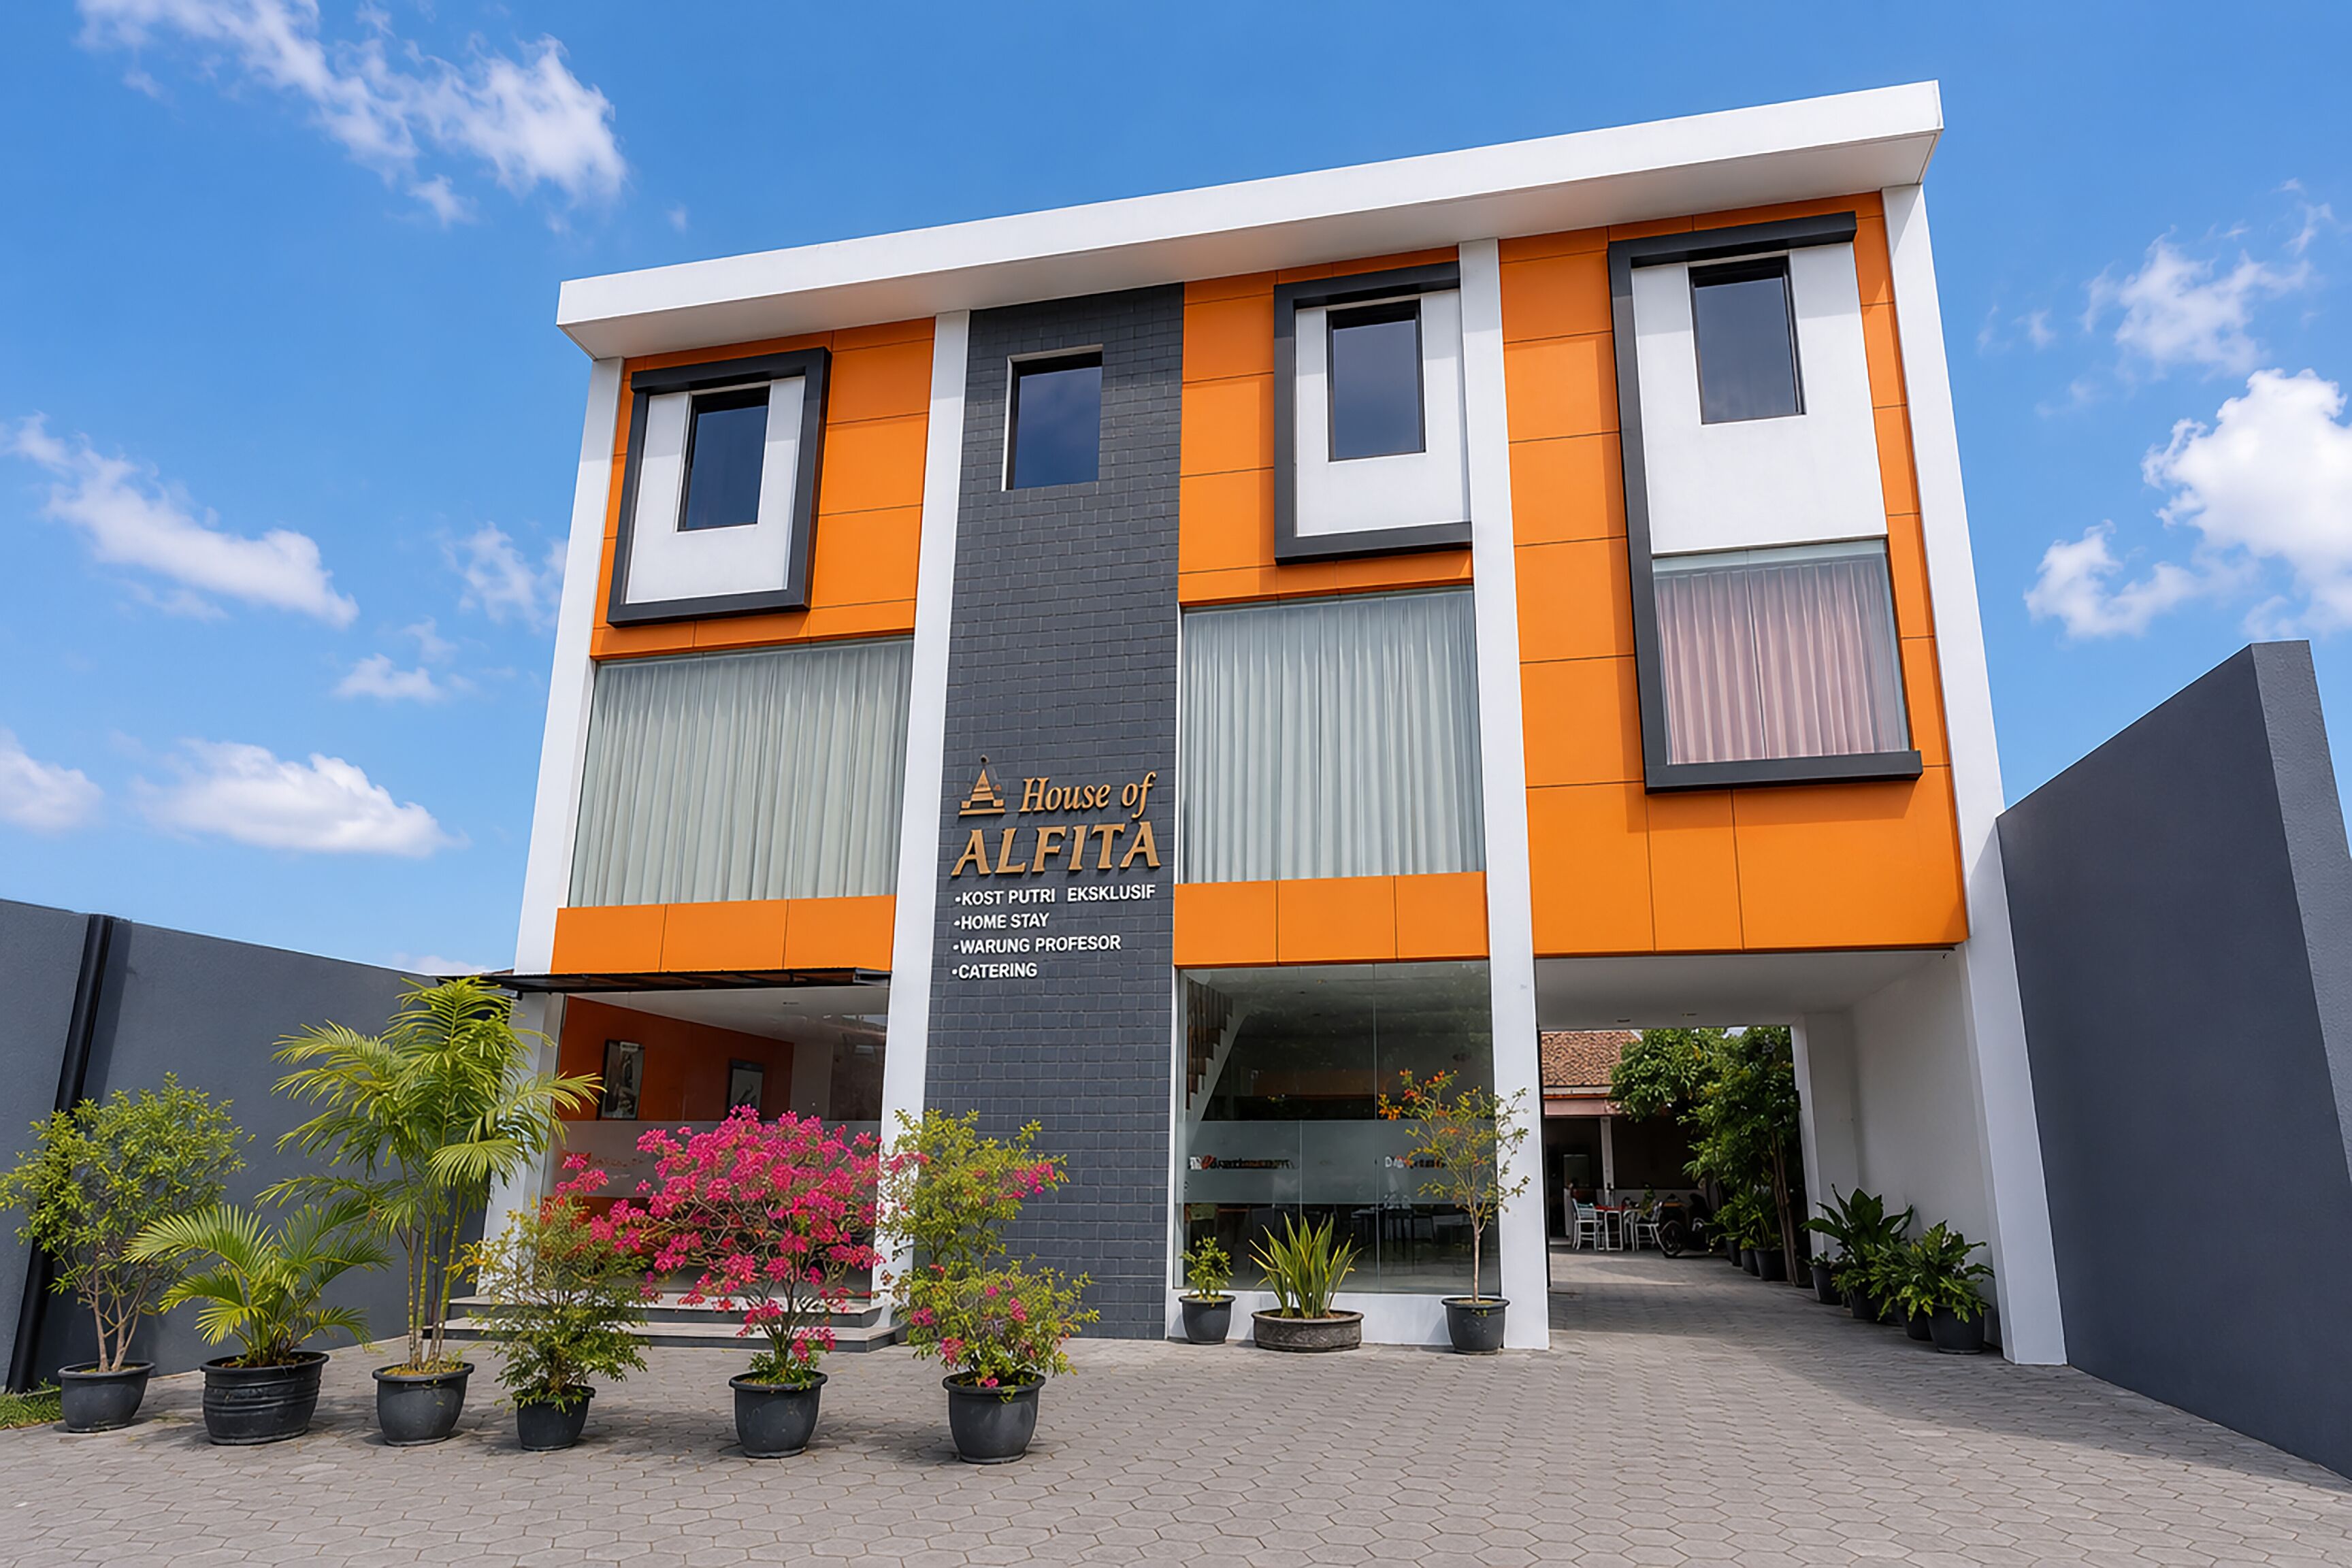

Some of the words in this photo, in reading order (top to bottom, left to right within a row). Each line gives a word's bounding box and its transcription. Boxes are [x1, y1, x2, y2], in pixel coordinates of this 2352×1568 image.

[1019, 777, 1111, 813] House
[1121, 771, 1156, 819] of
[951, 821, 1161, 877] ALFITA
[961, 889, 1004, 906] KOST
[1008, 888, 1056, 904] PUTRI
[1066, 884, 1156, 902] EKSKLUSIF
[960, 914, 1007, 930] HOME
[1009, 912, 1050, 928] STAY
[960, 937, 1030, 954] WARUNG
[1034, 934, 1122, 952] PROFESOR
[958, 962, 1038, 979] CATERING
